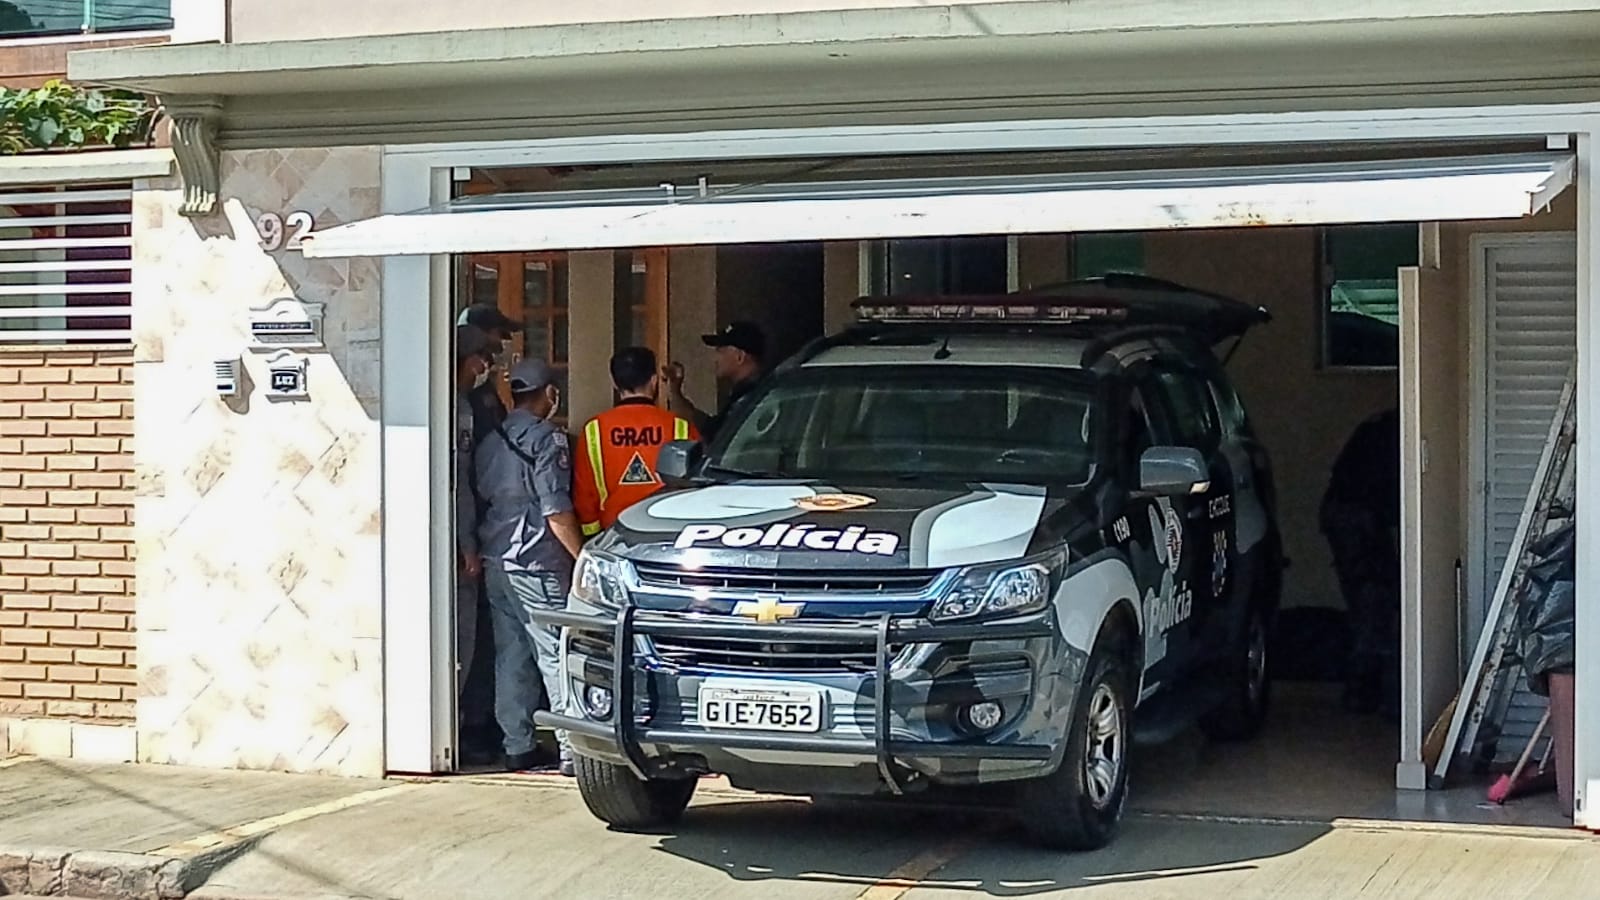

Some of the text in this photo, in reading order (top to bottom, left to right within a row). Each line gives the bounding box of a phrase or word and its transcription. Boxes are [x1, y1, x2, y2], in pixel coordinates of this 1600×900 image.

[256, 211, 315, 251] 92
[274, 376, 295, 385] LUZ
[611, 426, 662, 446] GRAU
[673, 523, 901, 555] Polícia
